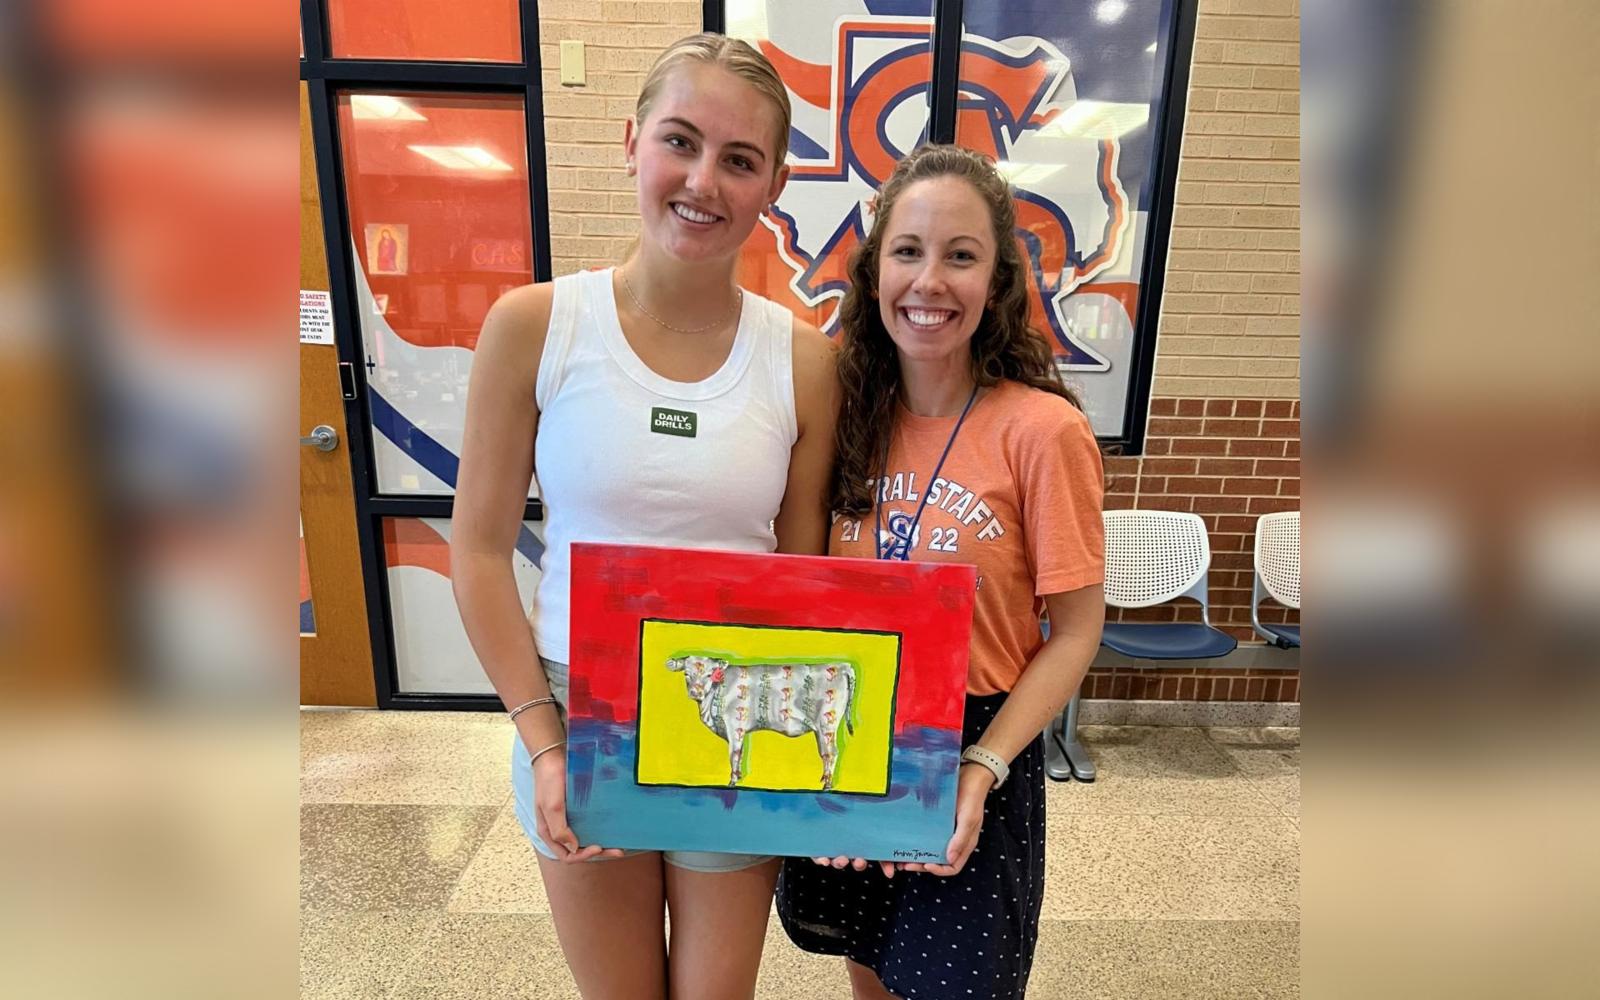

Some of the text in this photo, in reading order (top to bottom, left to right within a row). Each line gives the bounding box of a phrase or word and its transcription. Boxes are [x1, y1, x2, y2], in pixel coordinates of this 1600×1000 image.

[654, 419, 692, 430] DRILLS
[658, 412, 689, 423] DAILY
[866, 472, 1006, 542] RAL STAFF
[840, 520, 960, 553] 21 22
